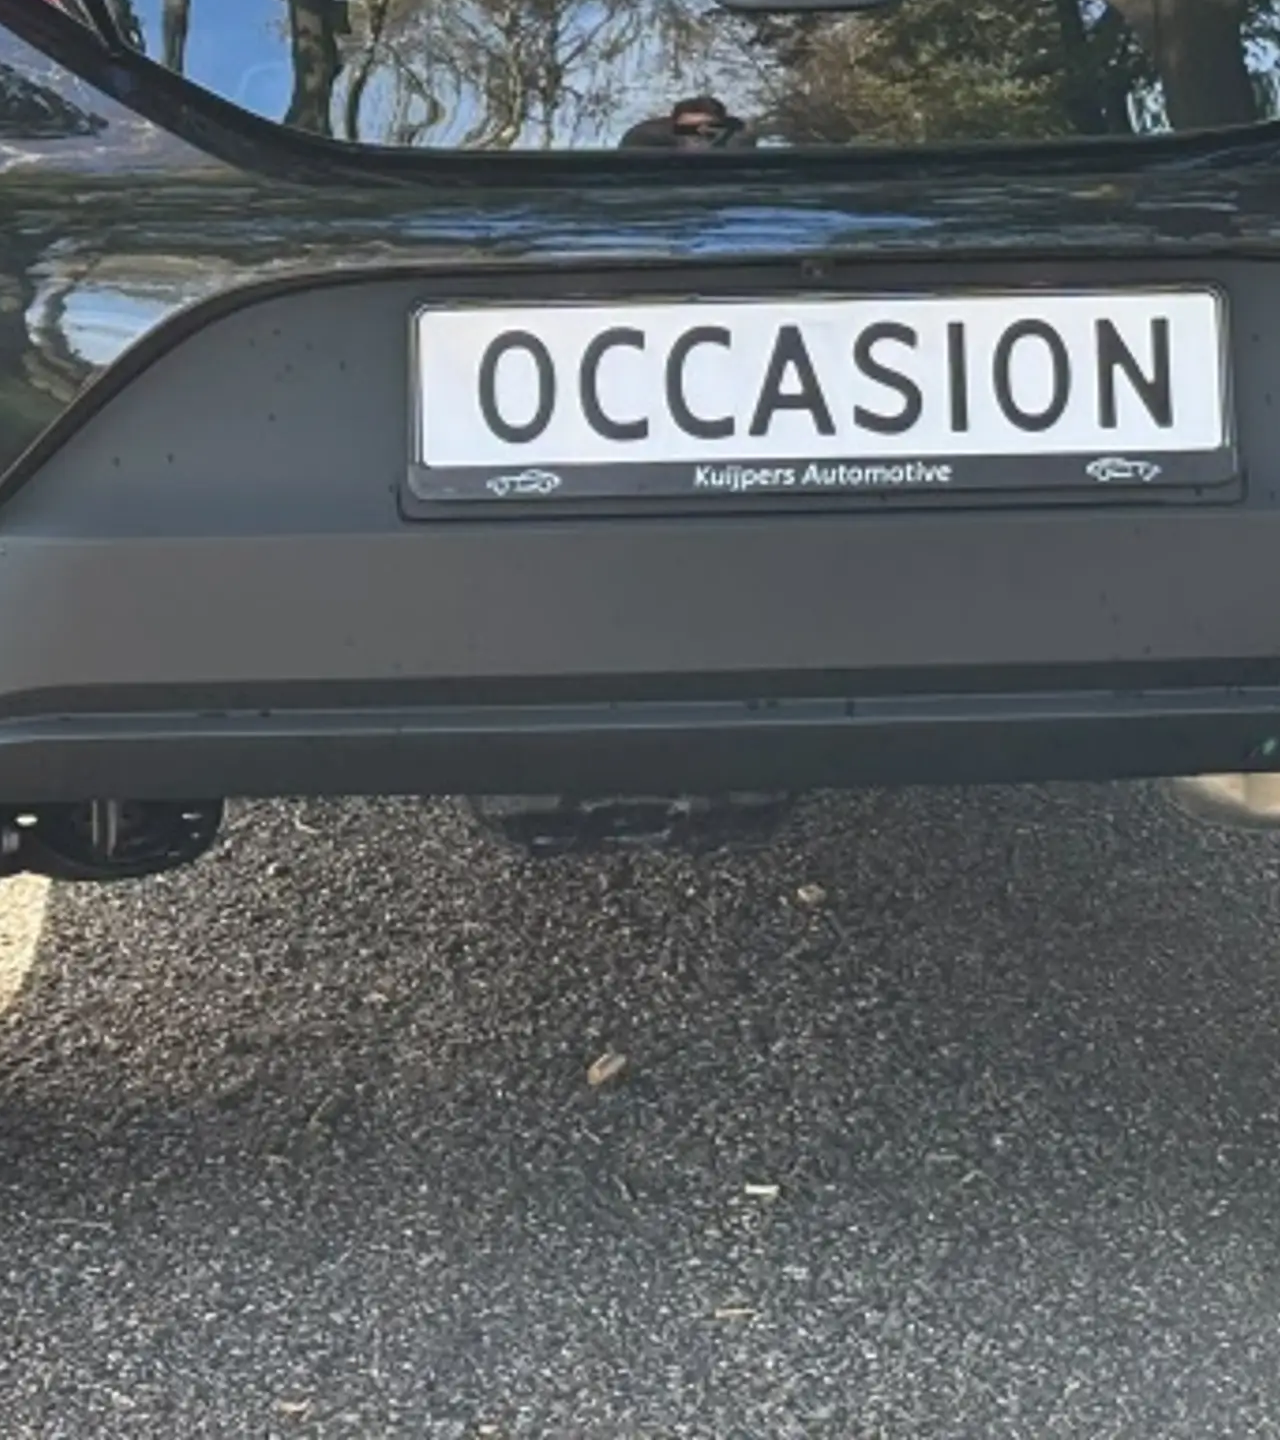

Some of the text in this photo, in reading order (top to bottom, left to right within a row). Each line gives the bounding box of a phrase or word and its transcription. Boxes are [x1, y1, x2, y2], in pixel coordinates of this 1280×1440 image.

[476, 317, 1174, 445] OCCASION
[693, 461, 953, 492] Kuijpers Automotive
